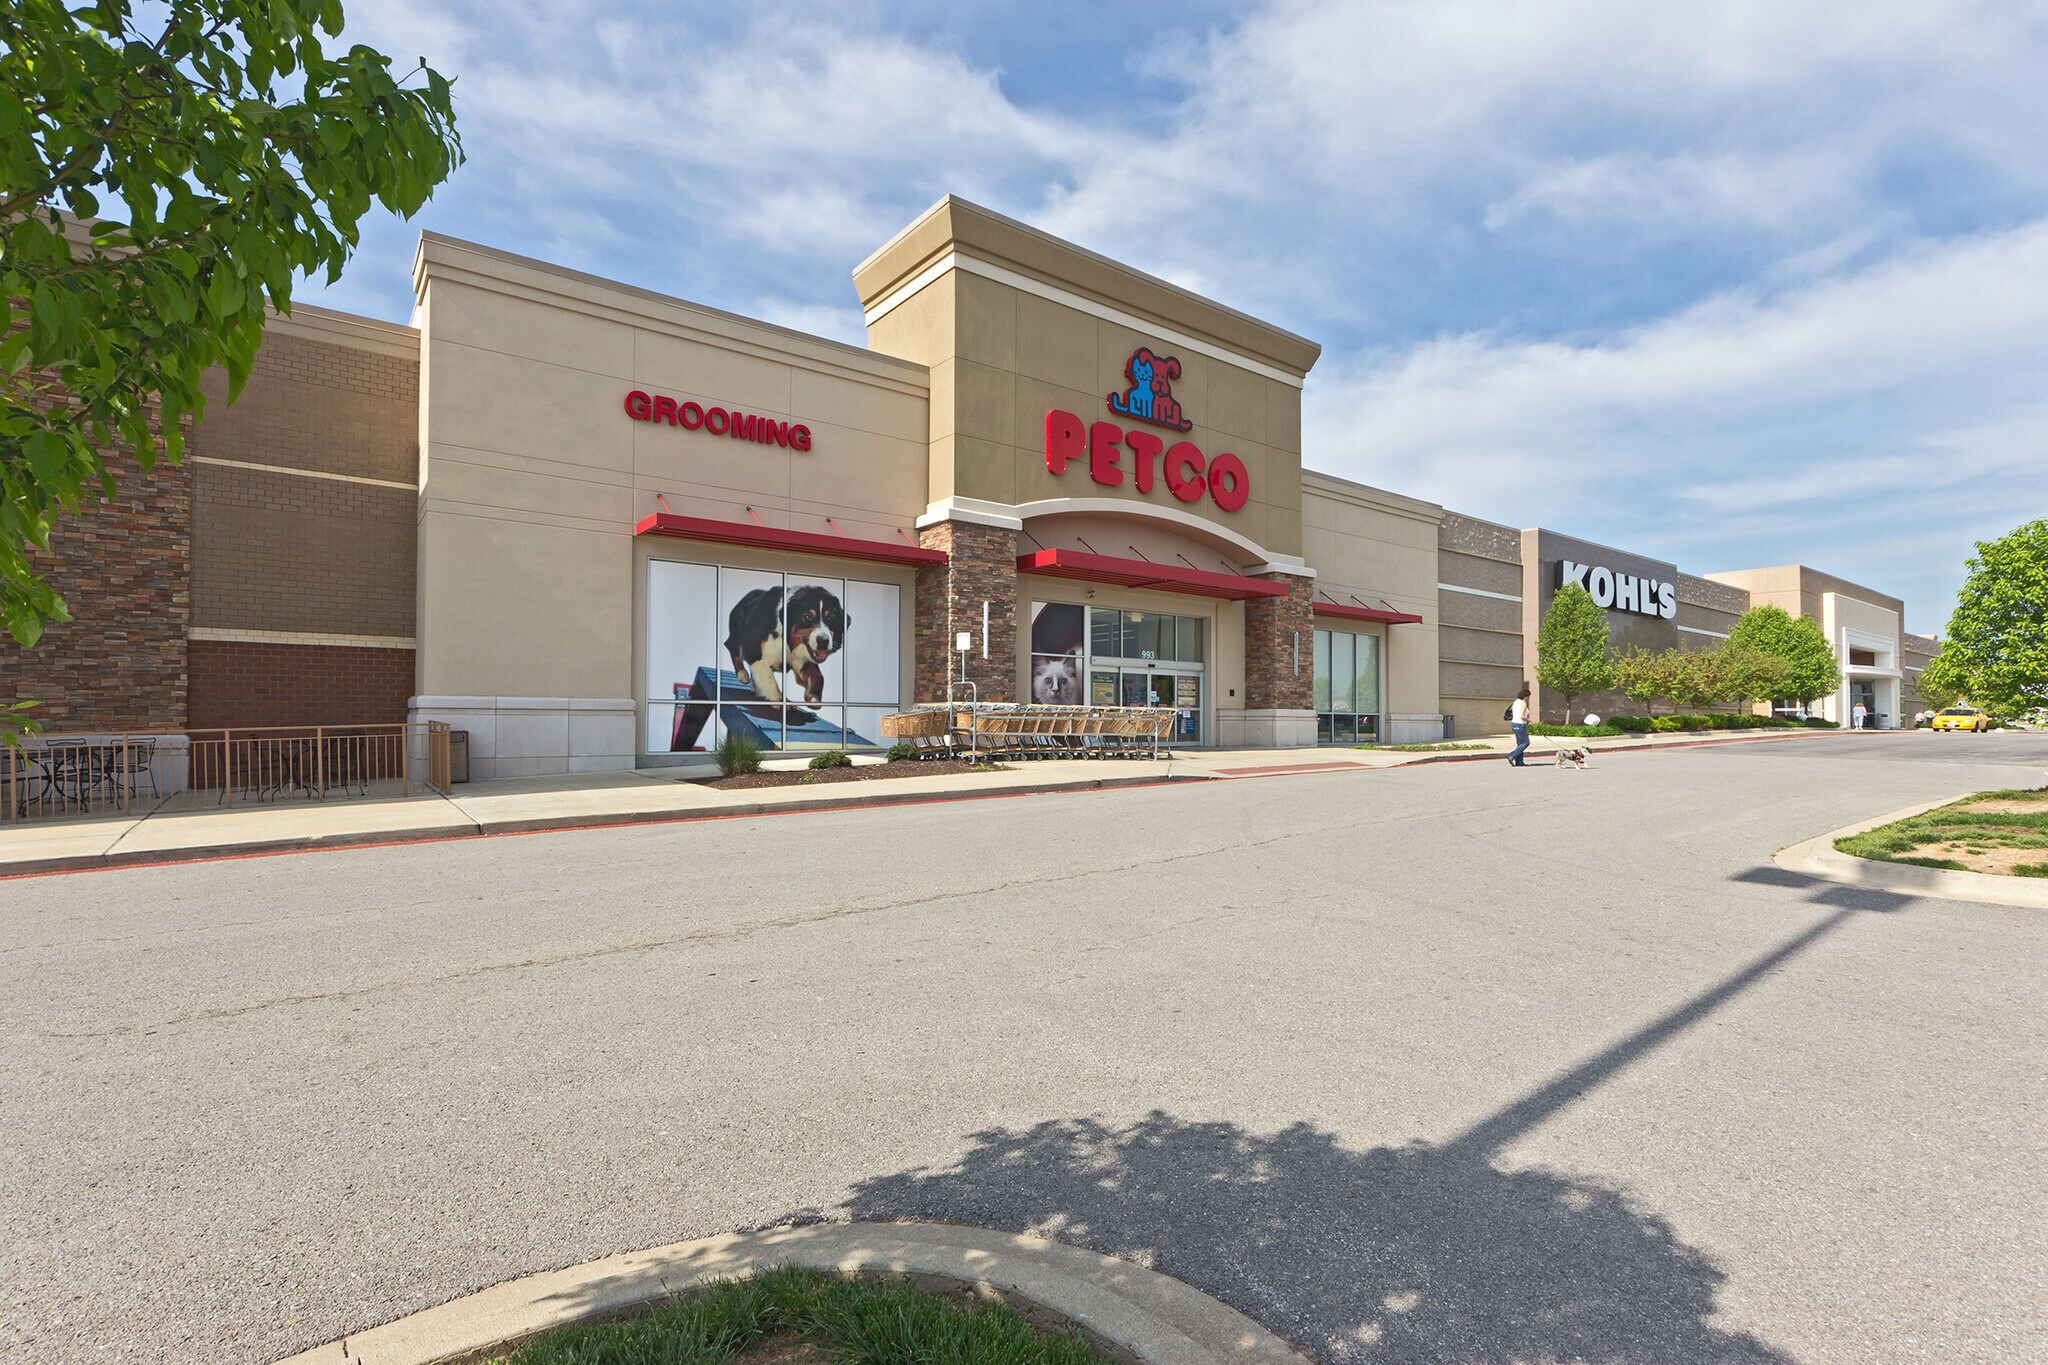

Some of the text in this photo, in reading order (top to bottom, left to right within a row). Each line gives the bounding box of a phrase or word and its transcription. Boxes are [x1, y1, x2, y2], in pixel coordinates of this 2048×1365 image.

[624, 390, 812, 452] GROOMING
[1046, 409, 1250, 512] PETCO
[1562, 560, 1677, 620] KOHL'S
[1141, 651, 1155, 660] 993
